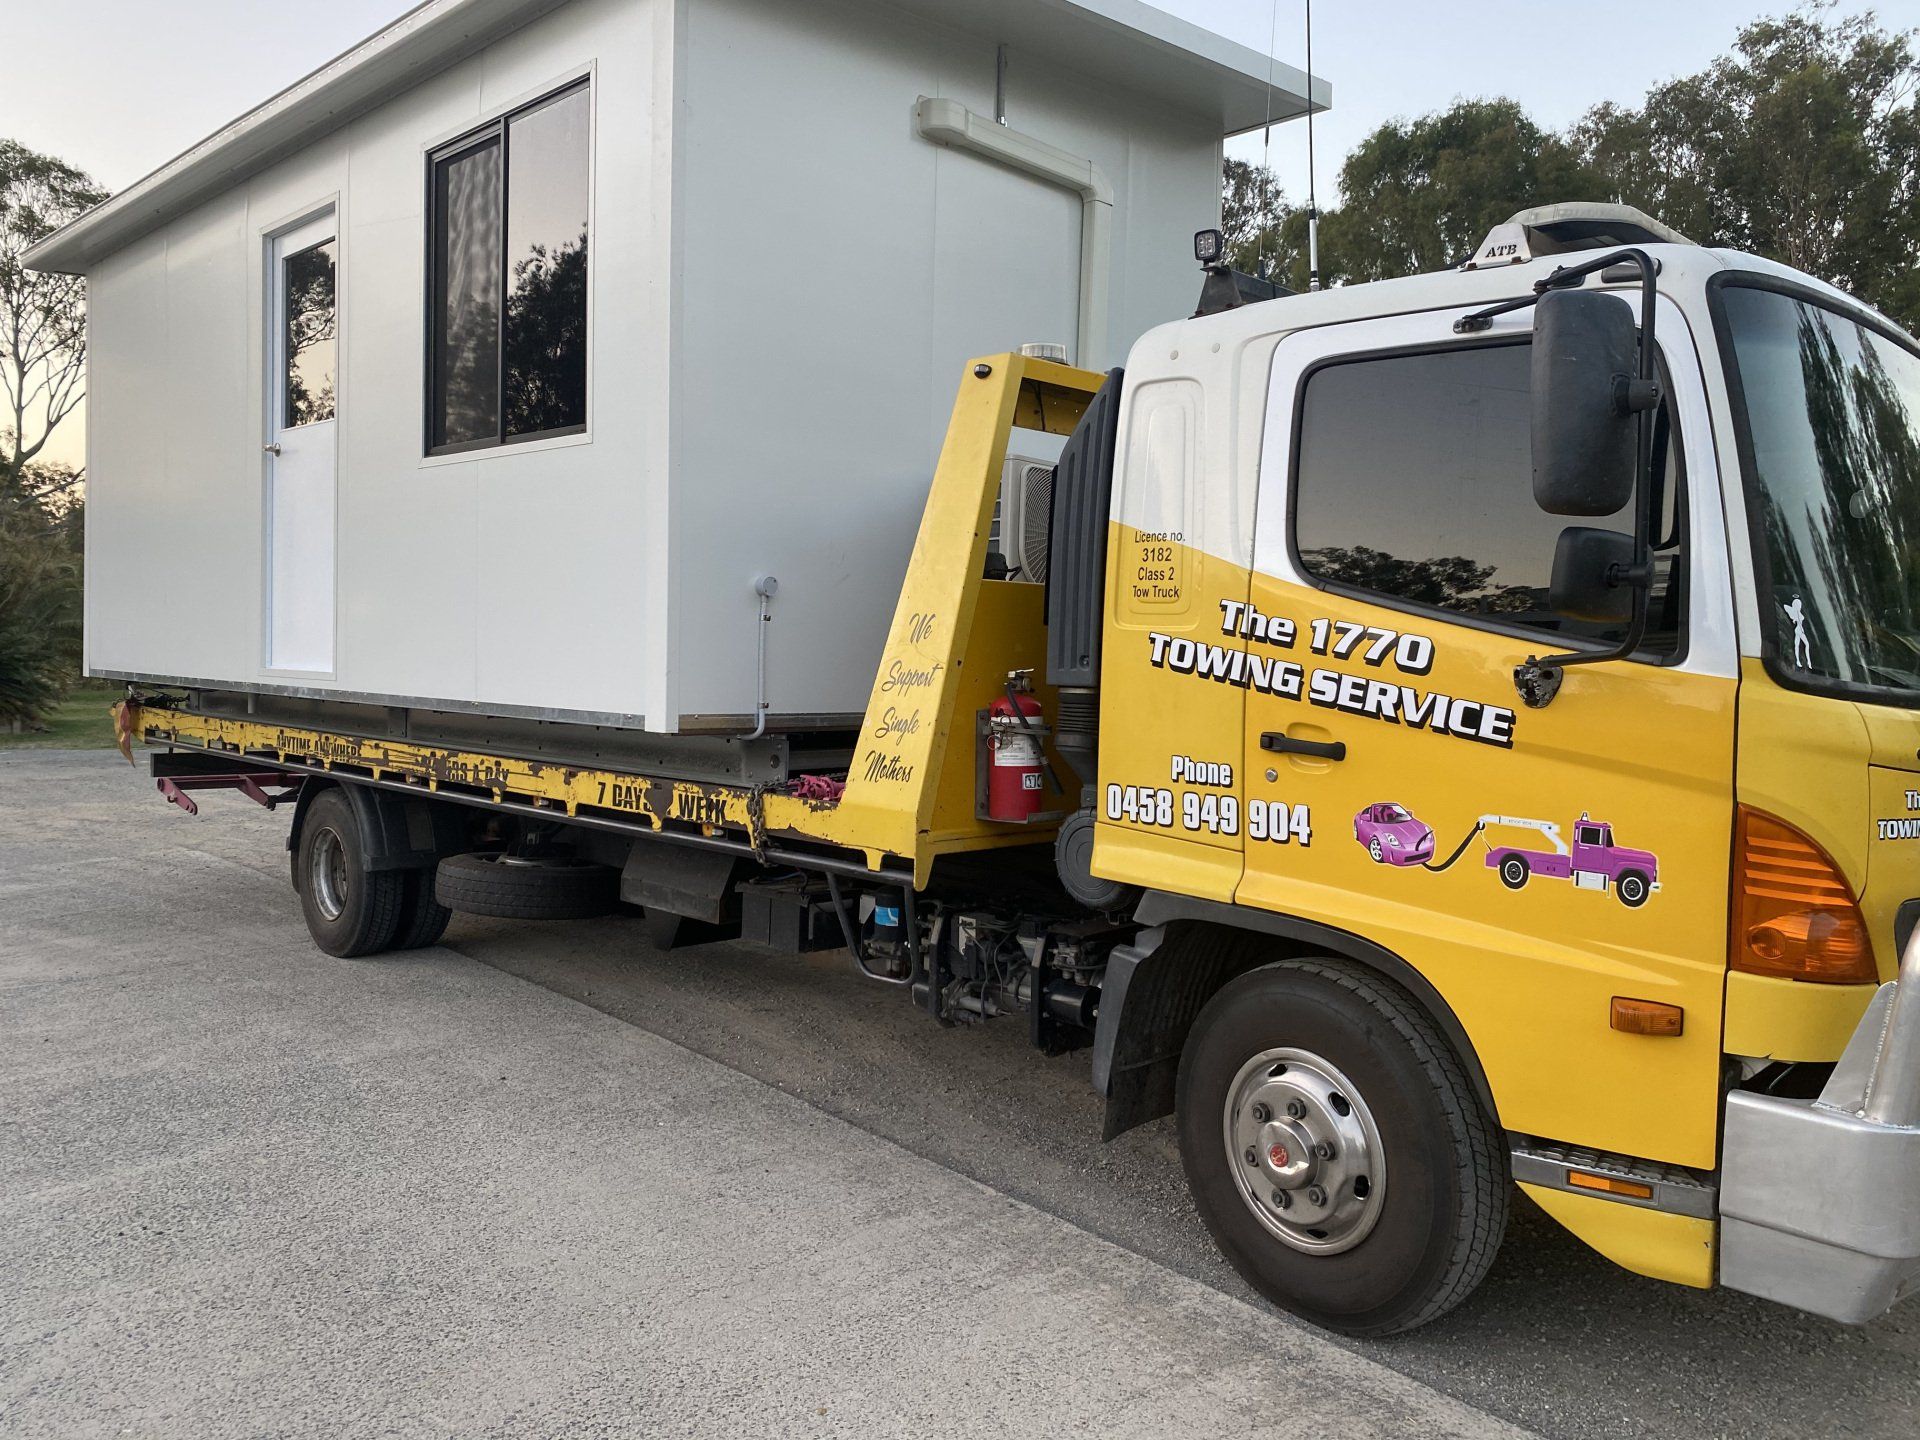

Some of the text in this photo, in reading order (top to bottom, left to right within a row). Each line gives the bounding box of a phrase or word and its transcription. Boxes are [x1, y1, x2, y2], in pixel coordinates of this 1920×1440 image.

[1485, 244, 1518, 258] ATB
[1134, 530, 1186, 544] Licence no.
[1142, 547, 1173, 562] 3182
[1137, 566, 1175, 581] Class 2
[1132, 585, 1180, 598] Tow Truck
[908, 612, 937, 645] We
[1220, 599, 1434, 676] The 1770
[881, 659, 944, 698] Support
[1149, 632, 1516, 749] TOWING SERVICE
[874, 706, 920, 746] Single
[864, 750, 914, 783] Mothers
[1171, 755, 1234, 788] Phone
[597, 782, 607, 805] 7
[1107, 783, 1312, 847] 0458 949 904
